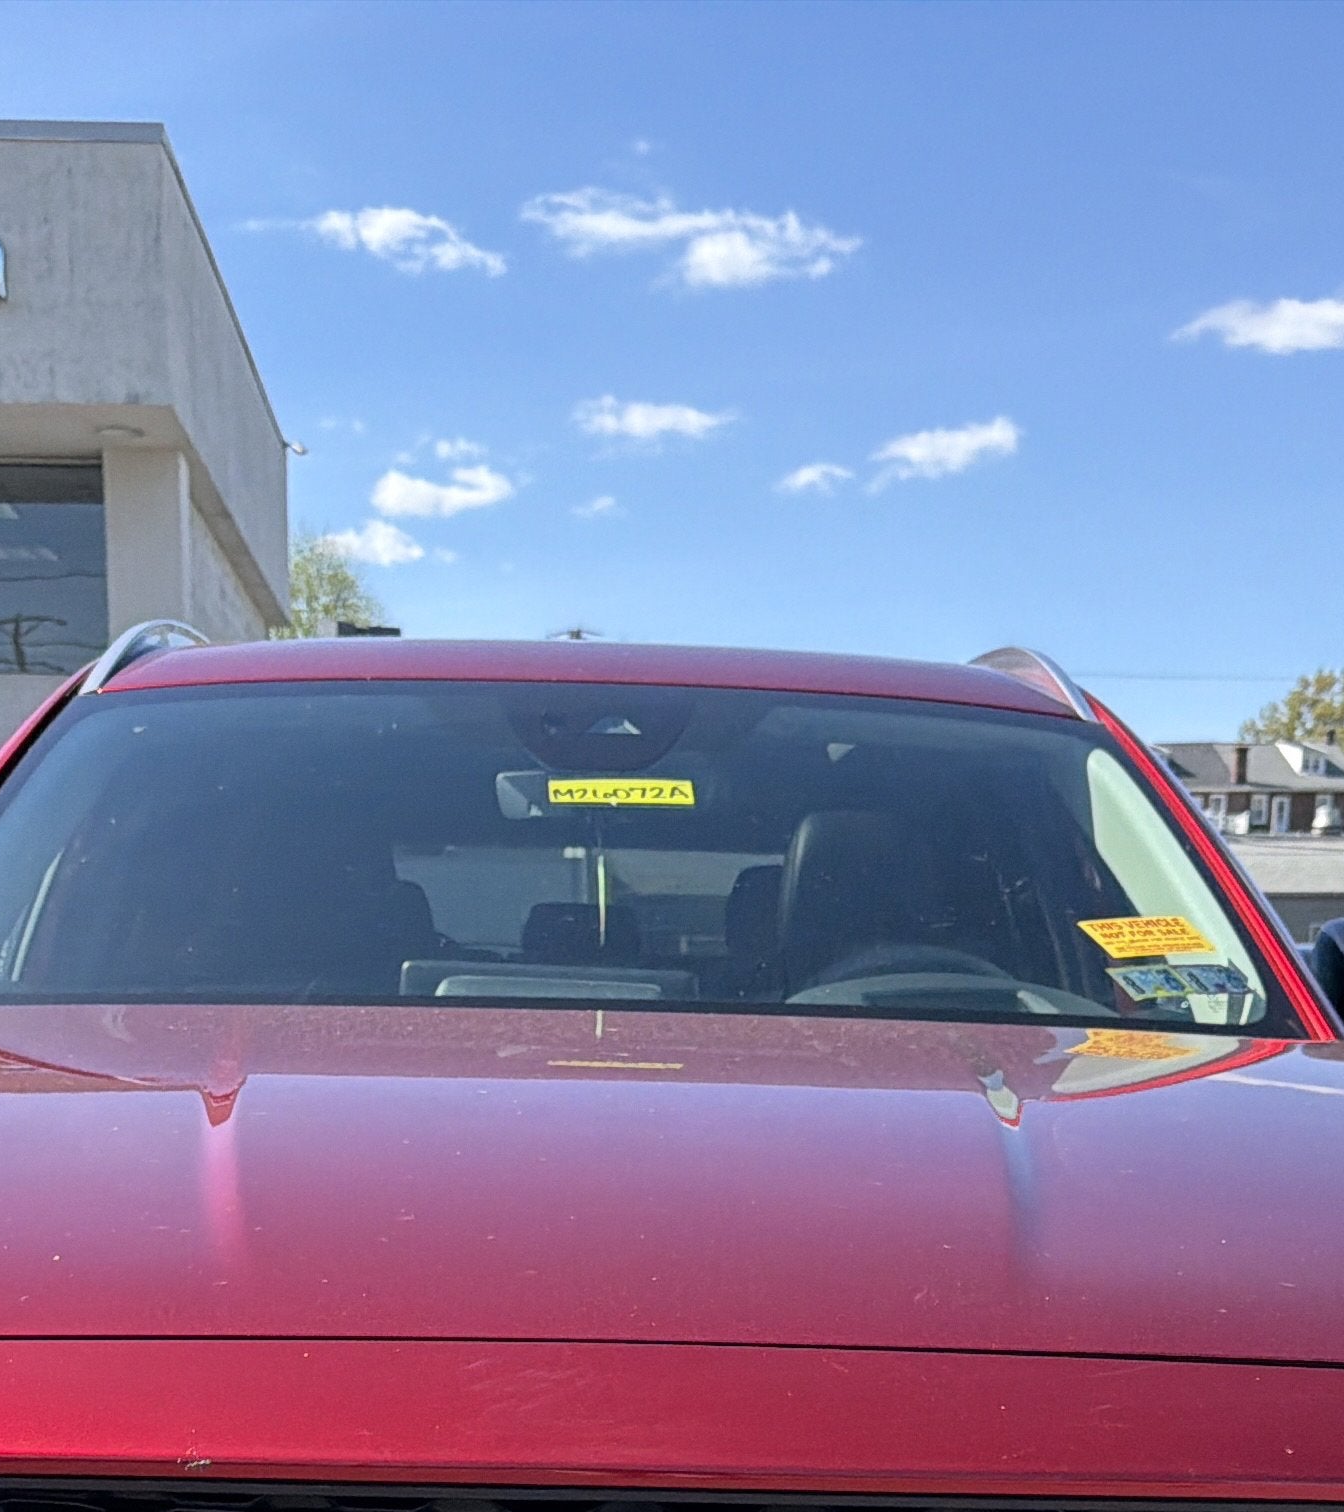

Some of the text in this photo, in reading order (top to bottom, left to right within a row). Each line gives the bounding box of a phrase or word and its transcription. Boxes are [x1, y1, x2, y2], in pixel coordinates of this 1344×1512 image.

[1087, 917, 1184, 933] THIS VEHICLE
[1130, 929, 1156, 938] FOR
[1157, 927, 1190, 937] SALE
